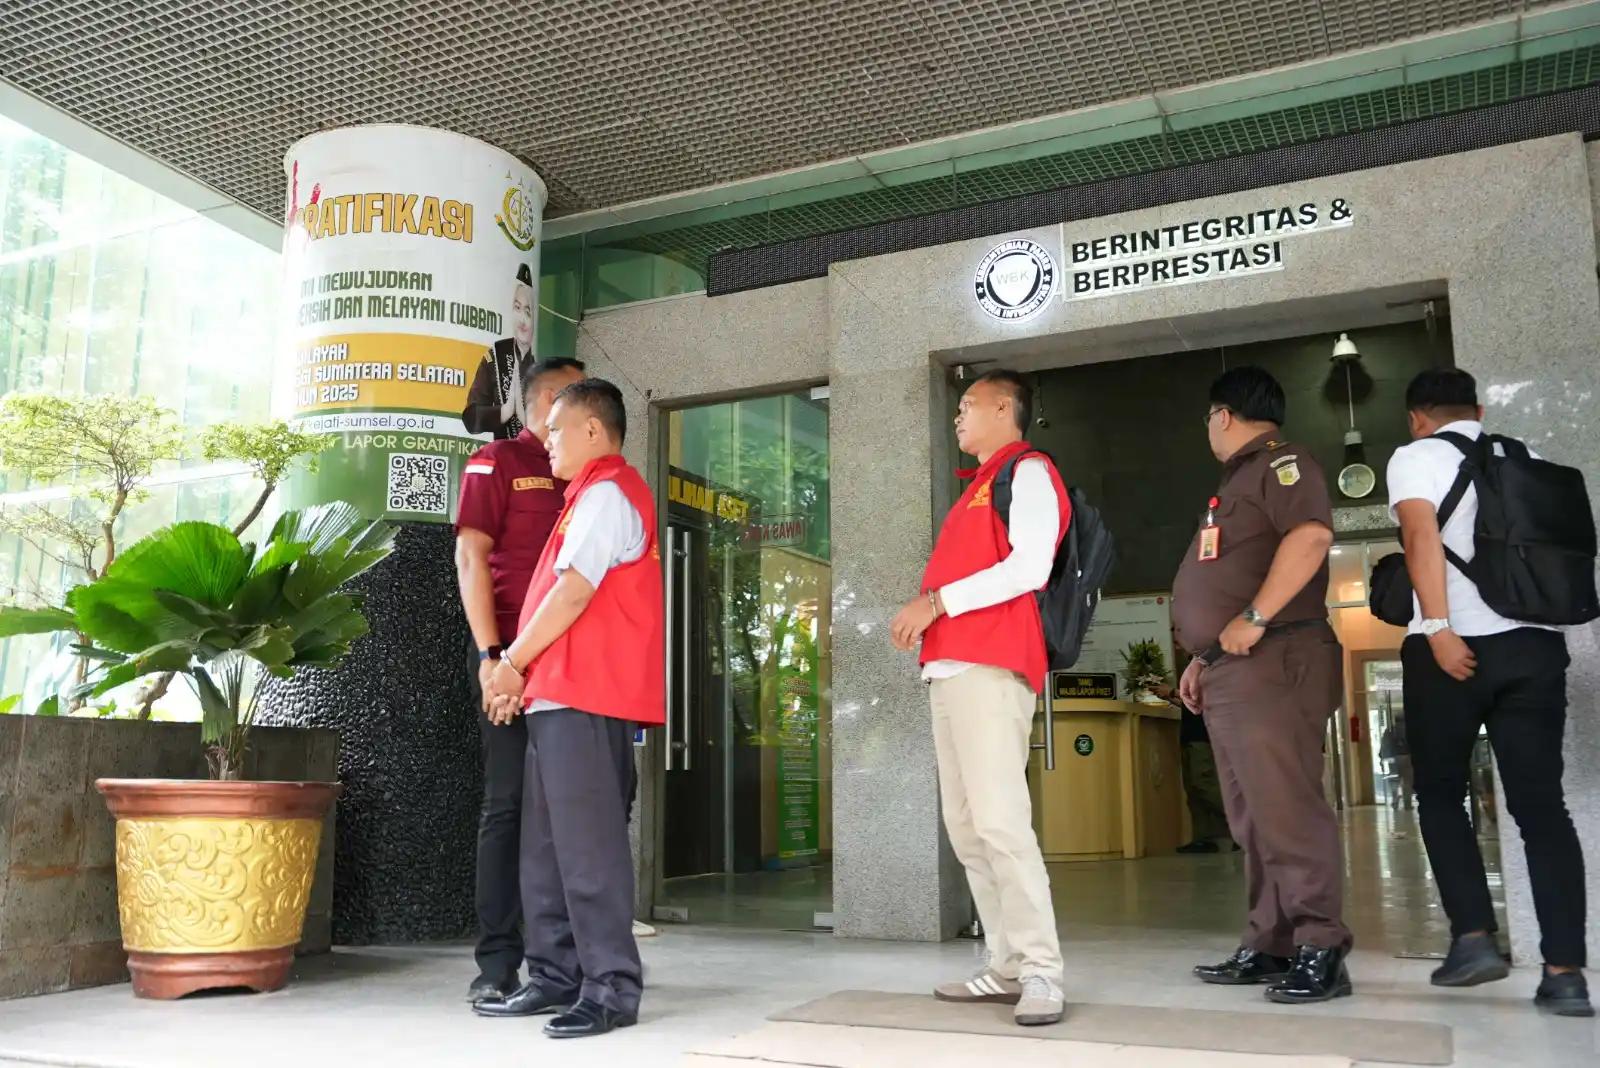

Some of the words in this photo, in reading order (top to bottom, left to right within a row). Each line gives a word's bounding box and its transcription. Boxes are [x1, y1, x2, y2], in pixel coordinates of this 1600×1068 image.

[1072, 203, 1317, 263] BERINTEGRITAS
[1330, 198, 1352, 220] &
[1074, 241, 1281, 293] BERPRESTASI
[334, 295, 363, 320] DAN
[367, 295, 445, 322] MELAYANI
[315, 362, 393, 383] SUMATERA
[397, 362, 465, 387] SELATAN
[321, 383, 359, 403] 2025
[345, 435, 397, 449] LAPOR
